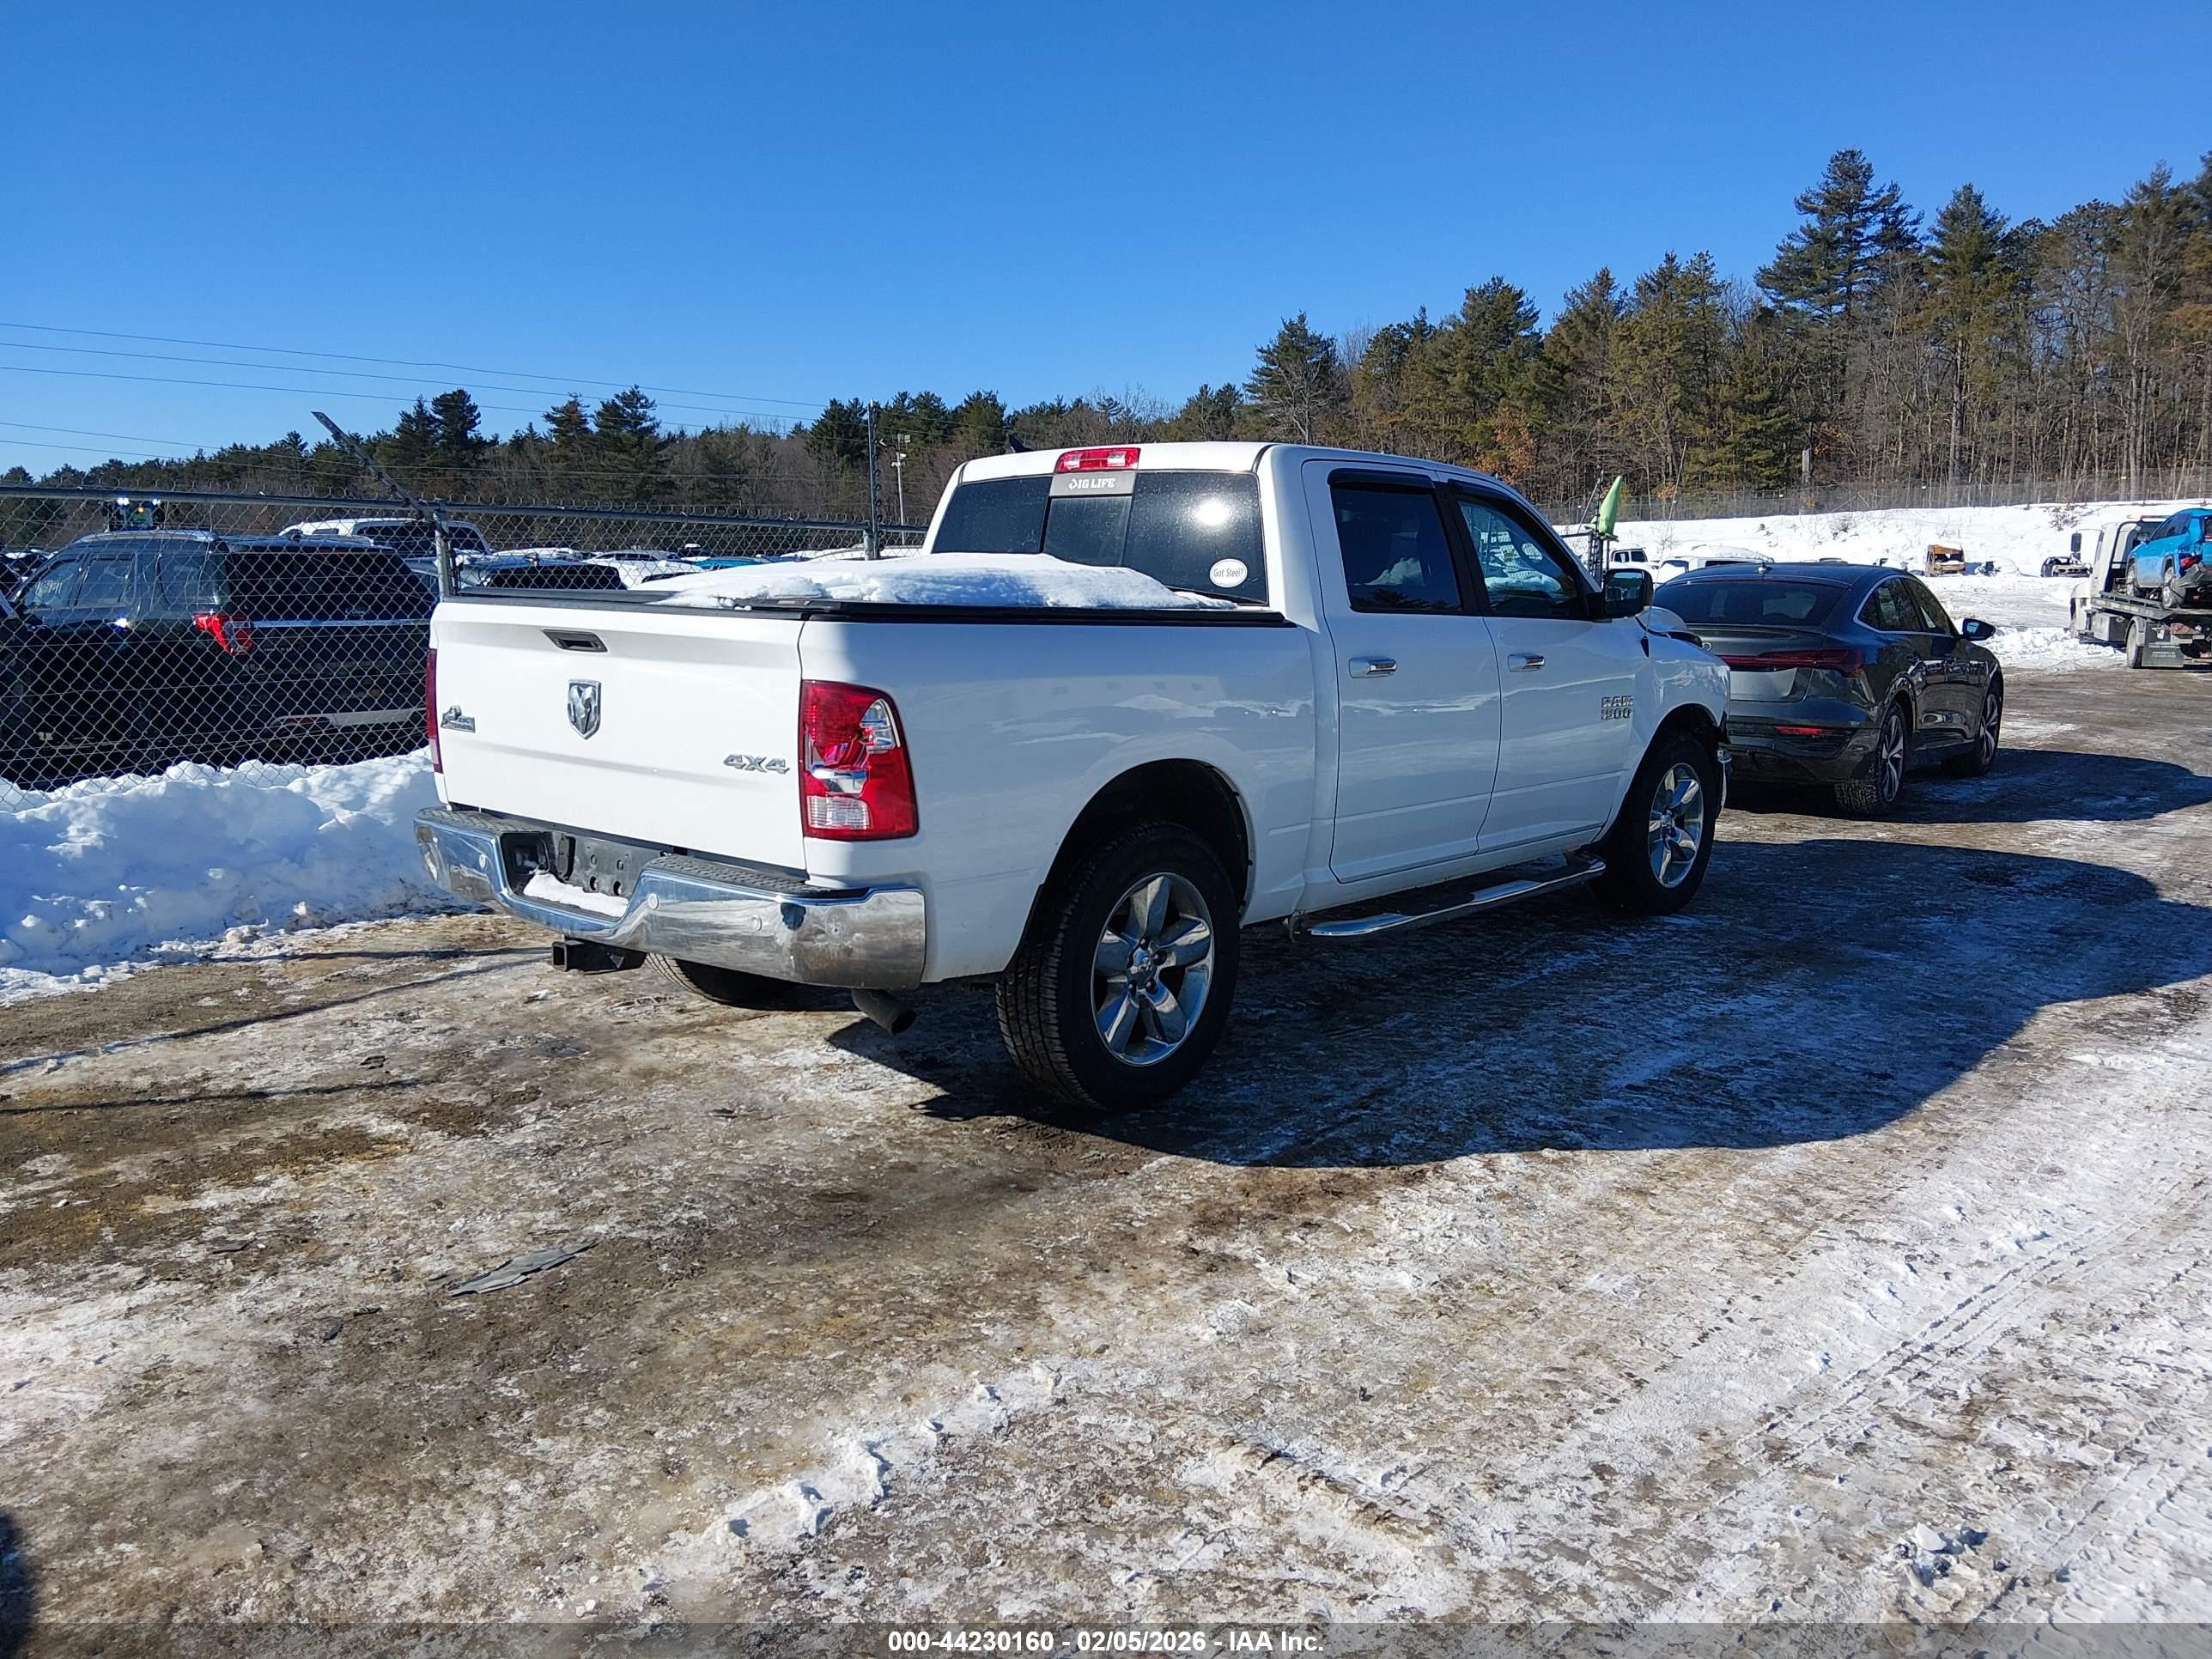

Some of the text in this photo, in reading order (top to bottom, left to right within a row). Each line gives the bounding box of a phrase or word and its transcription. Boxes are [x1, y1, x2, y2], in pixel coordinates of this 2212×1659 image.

[1091, 477, 1116, 489] LIFE
[1213, 568, 1244, 577] Got Steel?
[1601, 707, 1632, 720] 1500
